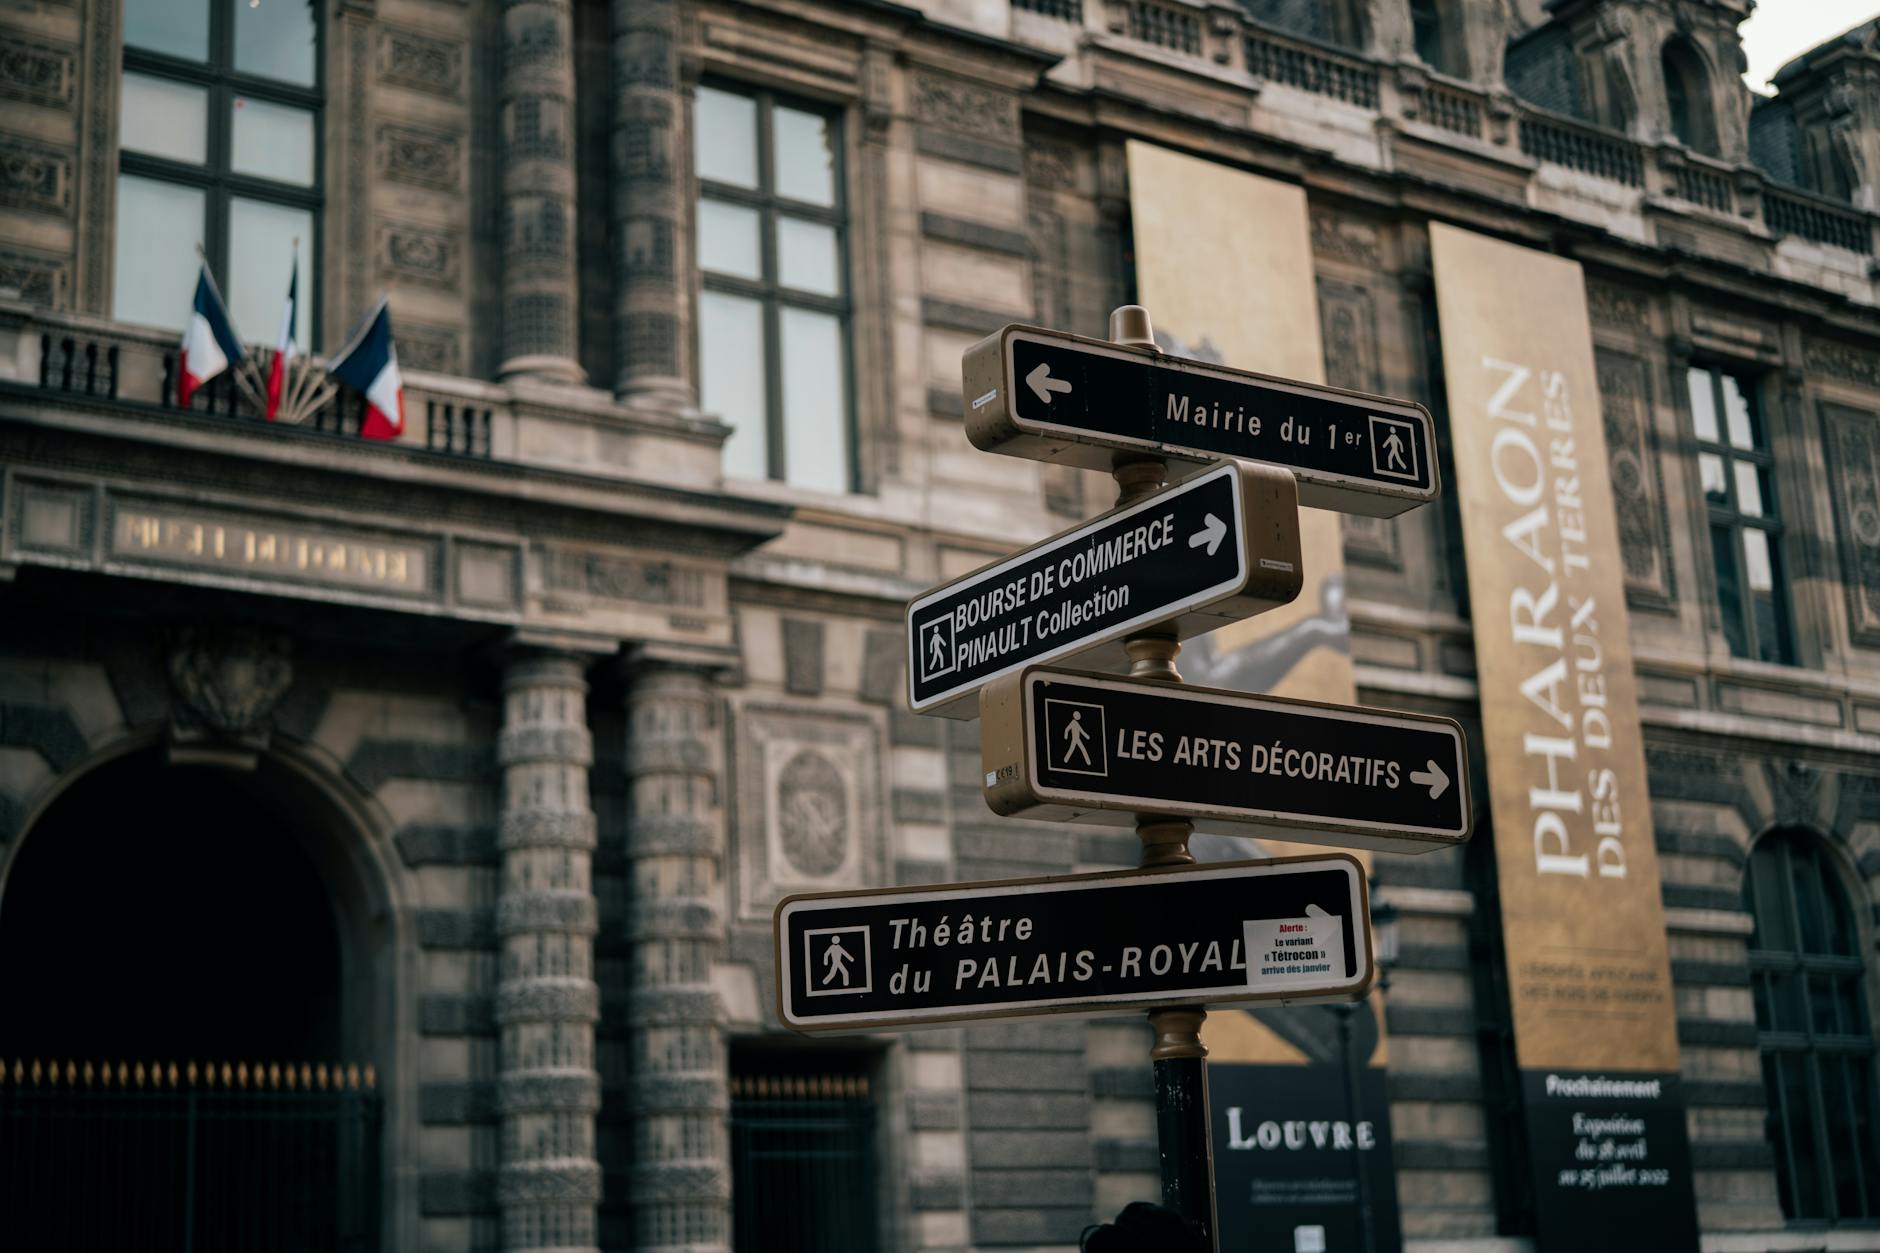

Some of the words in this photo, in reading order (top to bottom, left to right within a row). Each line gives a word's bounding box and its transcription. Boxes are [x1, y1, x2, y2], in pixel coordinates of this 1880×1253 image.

[1166, 393, 1262, 436] Mairie
[1280, 416, 1310, 445] du
[1540, 369, 1591, 577] TERRES
[955, 577, 1026, 633] BOURSE
[1030, 565, 1055, 602] DE
[1058, 513, 1175, 588] COMMERCE
[956, 616, 1032, 672] PINAULT
[1036, 584, 1129, 640] Collection
[1481, 354, 1590, 880] PHARAON
[1569, 593, 1613, 751] DEUX
[1117, 728, 1164, 762] LES
[1173, 736, 1241, 771] ARTS
[1251, 741, 1401, 789] DÉCORATIFS
[1589, 767, 1627, 880] DES
[888, 914, 1033, 950] Théâtre
[1275, 939, 1284, 947] Le
[1285, 937, 1313, 946] variant
[1280, 924, 1303, 933] Alerte
[889, 963, 932, 995] du
[955, 939, 1247, 990] PALAIS-ROYAL
[1261, 966, 1285, 975] arrive
[1302, 964, 1331, 974] janvier
[1546, 1074, 1661, 1099] Prochainement
